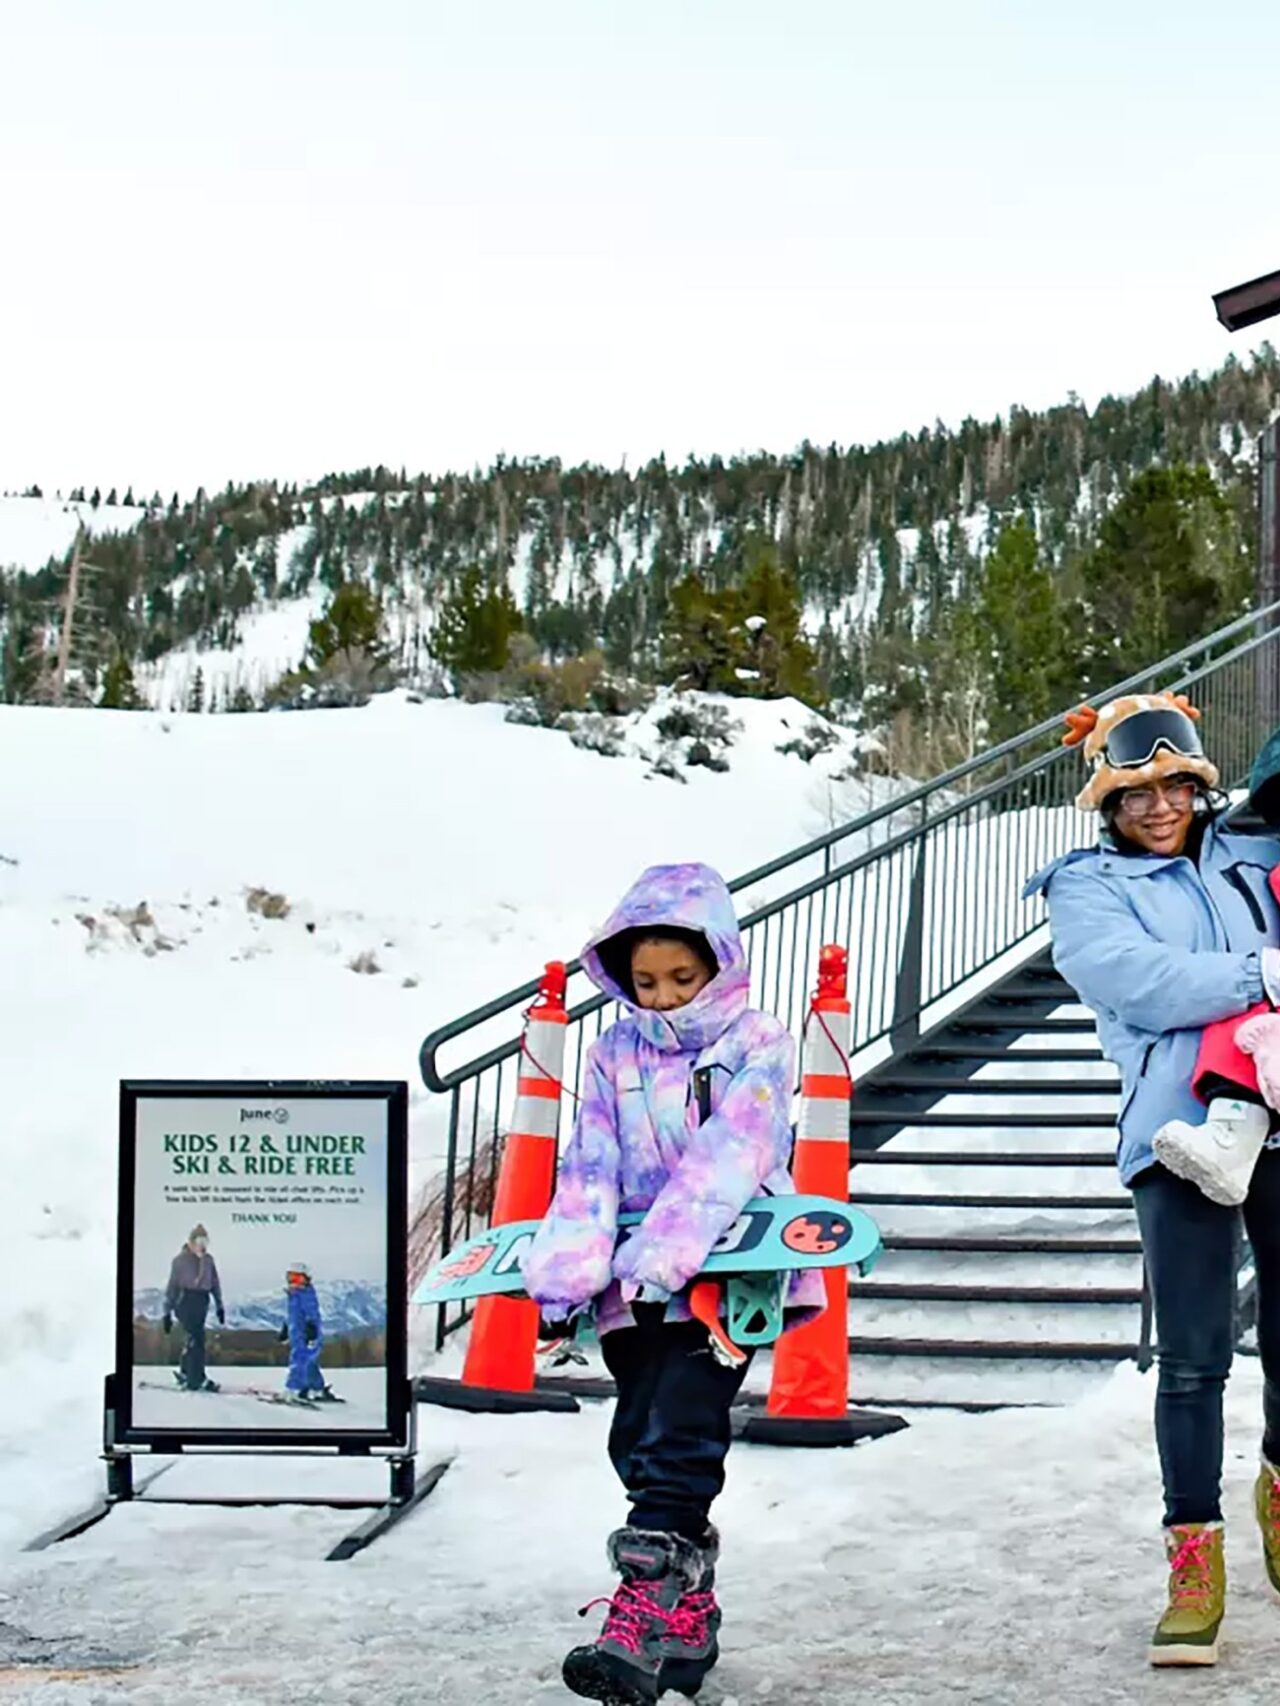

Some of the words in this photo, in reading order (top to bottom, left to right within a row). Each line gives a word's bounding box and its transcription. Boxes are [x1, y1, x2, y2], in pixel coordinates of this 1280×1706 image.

[163, 1134, 218, 1153] KIDS
[229, 1135, 251, 1153] 12
[259, 1135, 280, 1154] &
[287, 1135, 366, 1155] UNDER
[172, 1156, 210, 1174] SKI
[217, 1157, 237, 1175] &
[244, 1157, 297, 1175] RIDE
[305, 1157, 356, 1176] FREE
[231, 1212, 271, 1225] THANK
[273, 1212, 298, 1224] YOU
